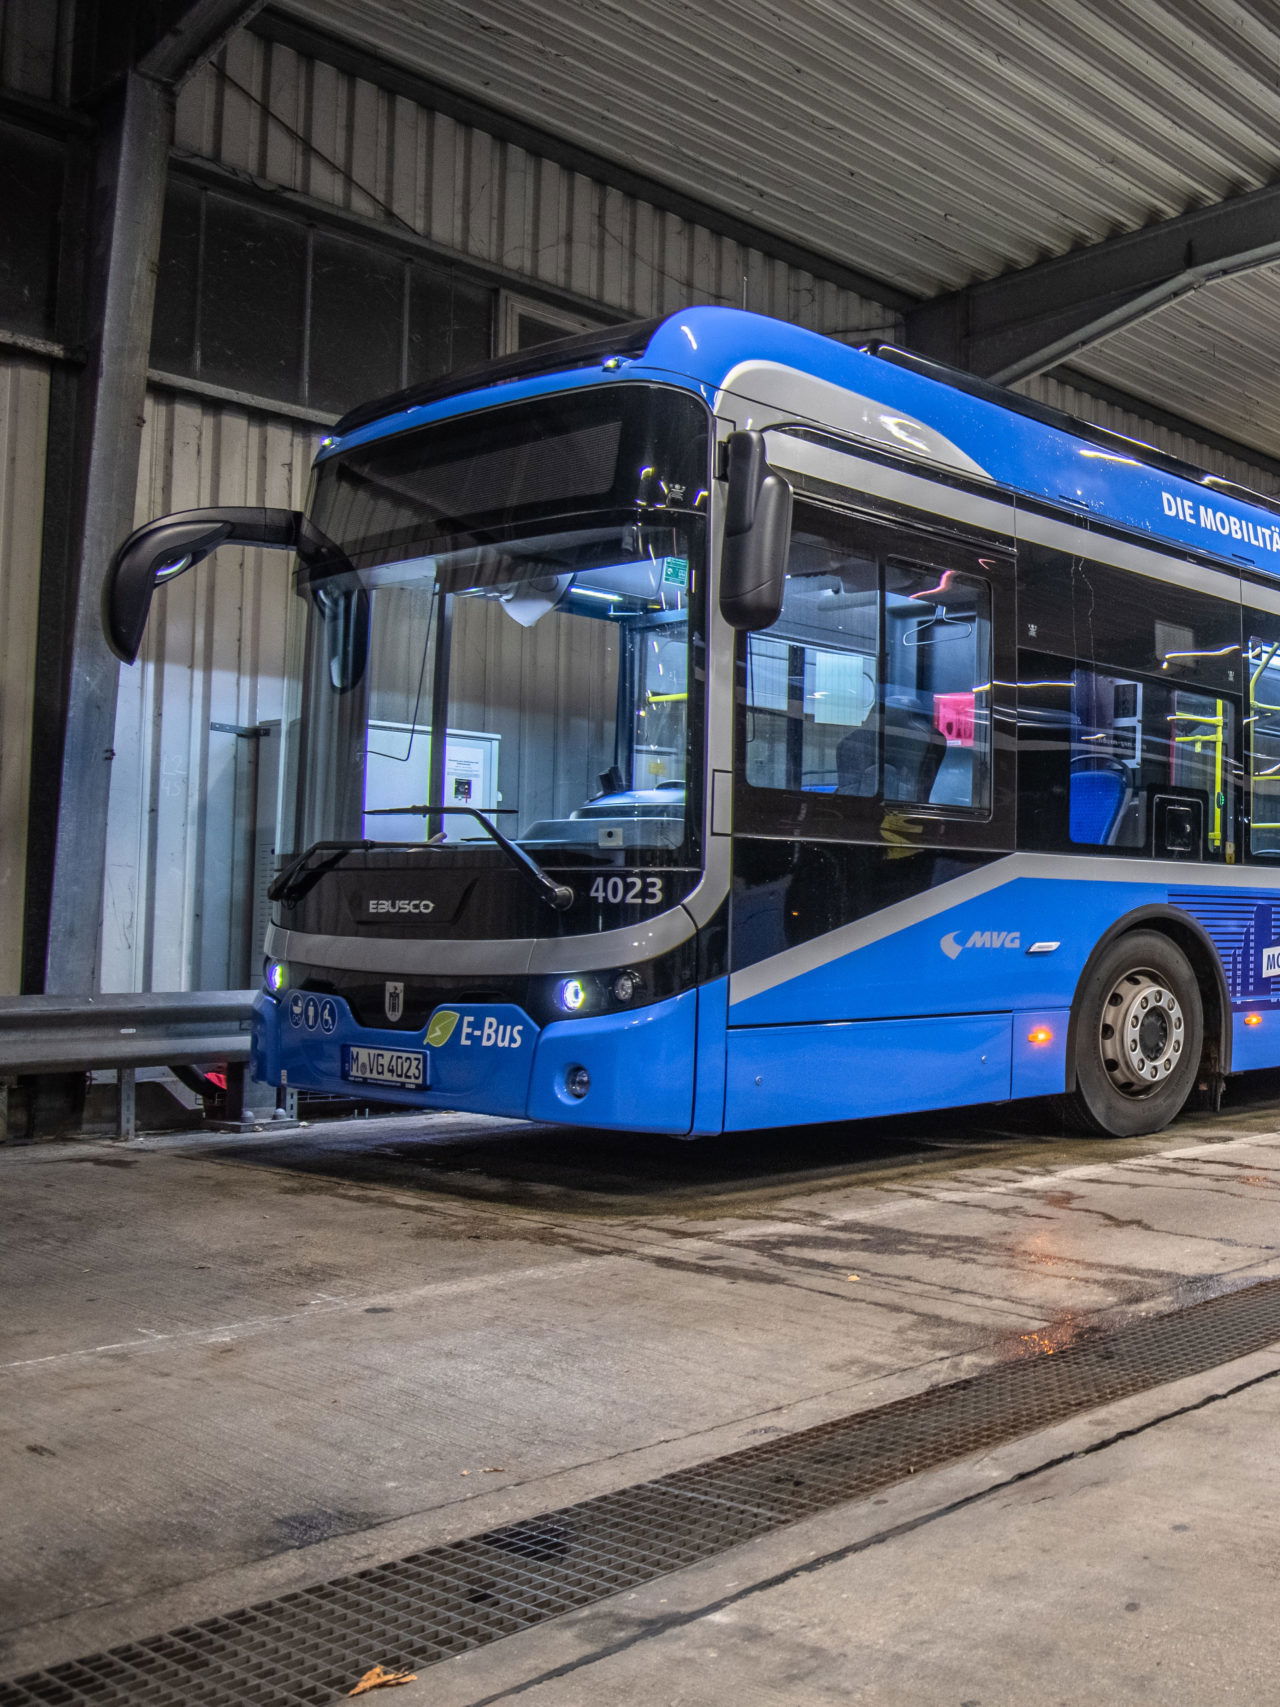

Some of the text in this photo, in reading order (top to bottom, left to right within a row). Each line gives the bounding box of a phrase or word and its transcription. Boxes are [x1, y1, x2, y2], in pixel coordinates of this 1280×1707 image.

[1162, 492, 1196, 524] DIE
[590, 877, 664, 905] 4023
[369, 900, 435, 914] EBUSCO
[965, 931, 1020, 948] MVG
[460, 1016, 524, 1049] E-Bus
[351, 1051, 421, 1080] M VG 4023
